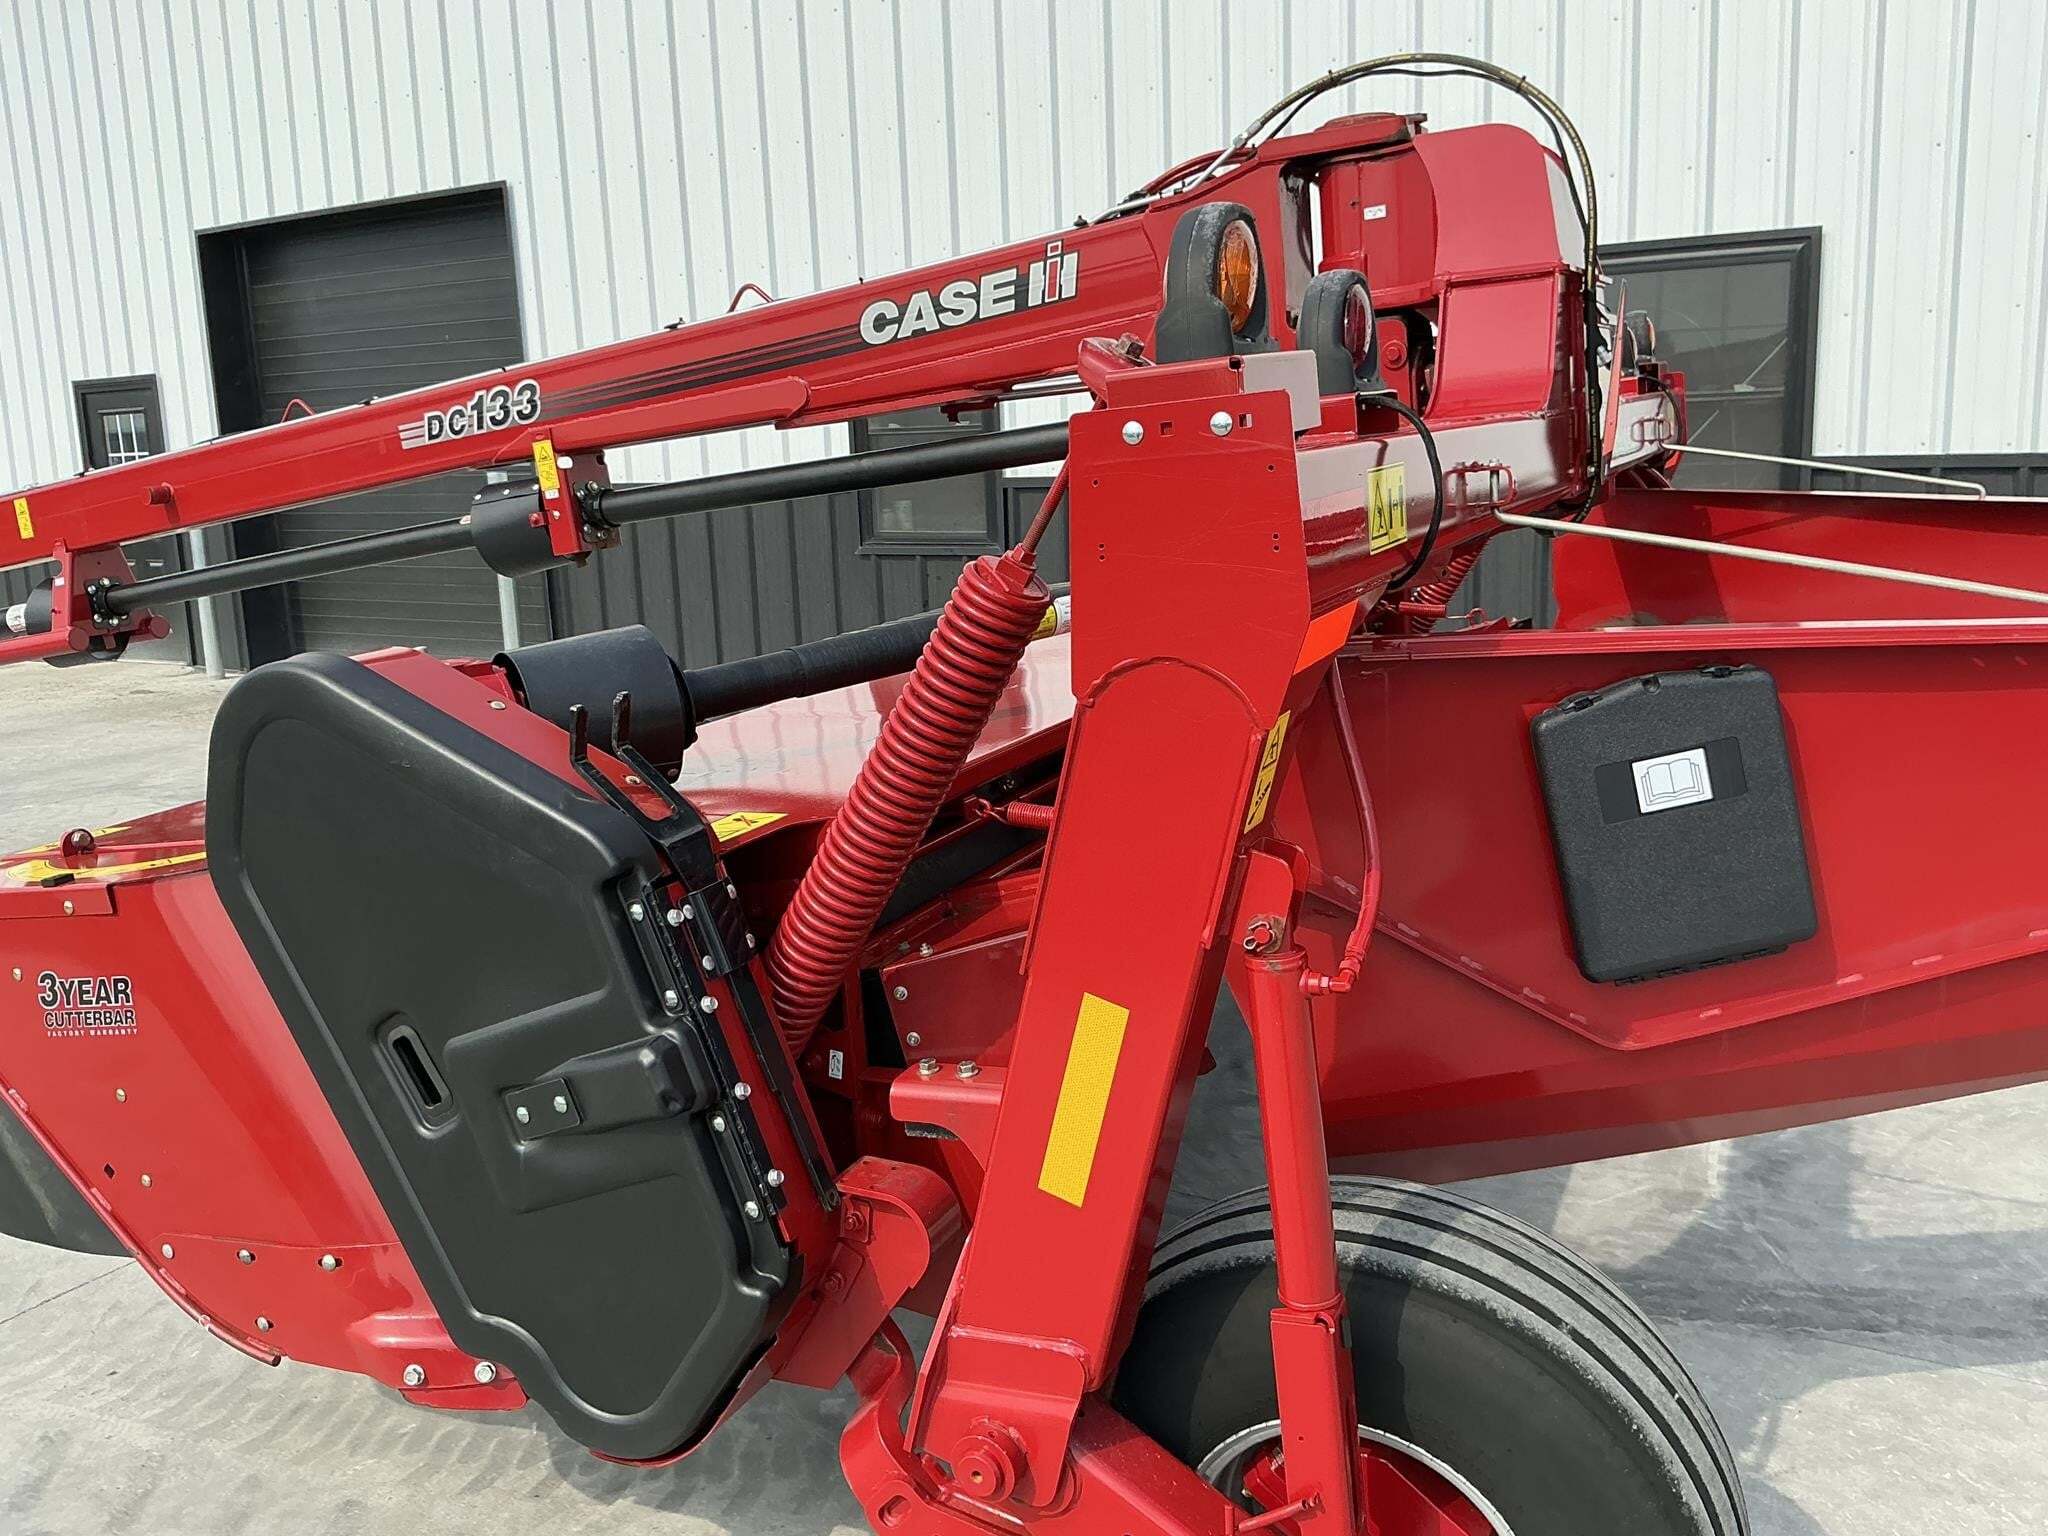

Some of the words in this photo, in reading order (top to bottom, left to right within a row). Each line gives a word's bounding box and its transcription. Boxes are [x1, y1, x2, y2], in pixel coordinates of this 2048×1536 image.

[859, 268, 1018, 345] CASE
[424, 378, 541, 443] DC133
[44, 1008, 137, 1028] CUTTERBAR
